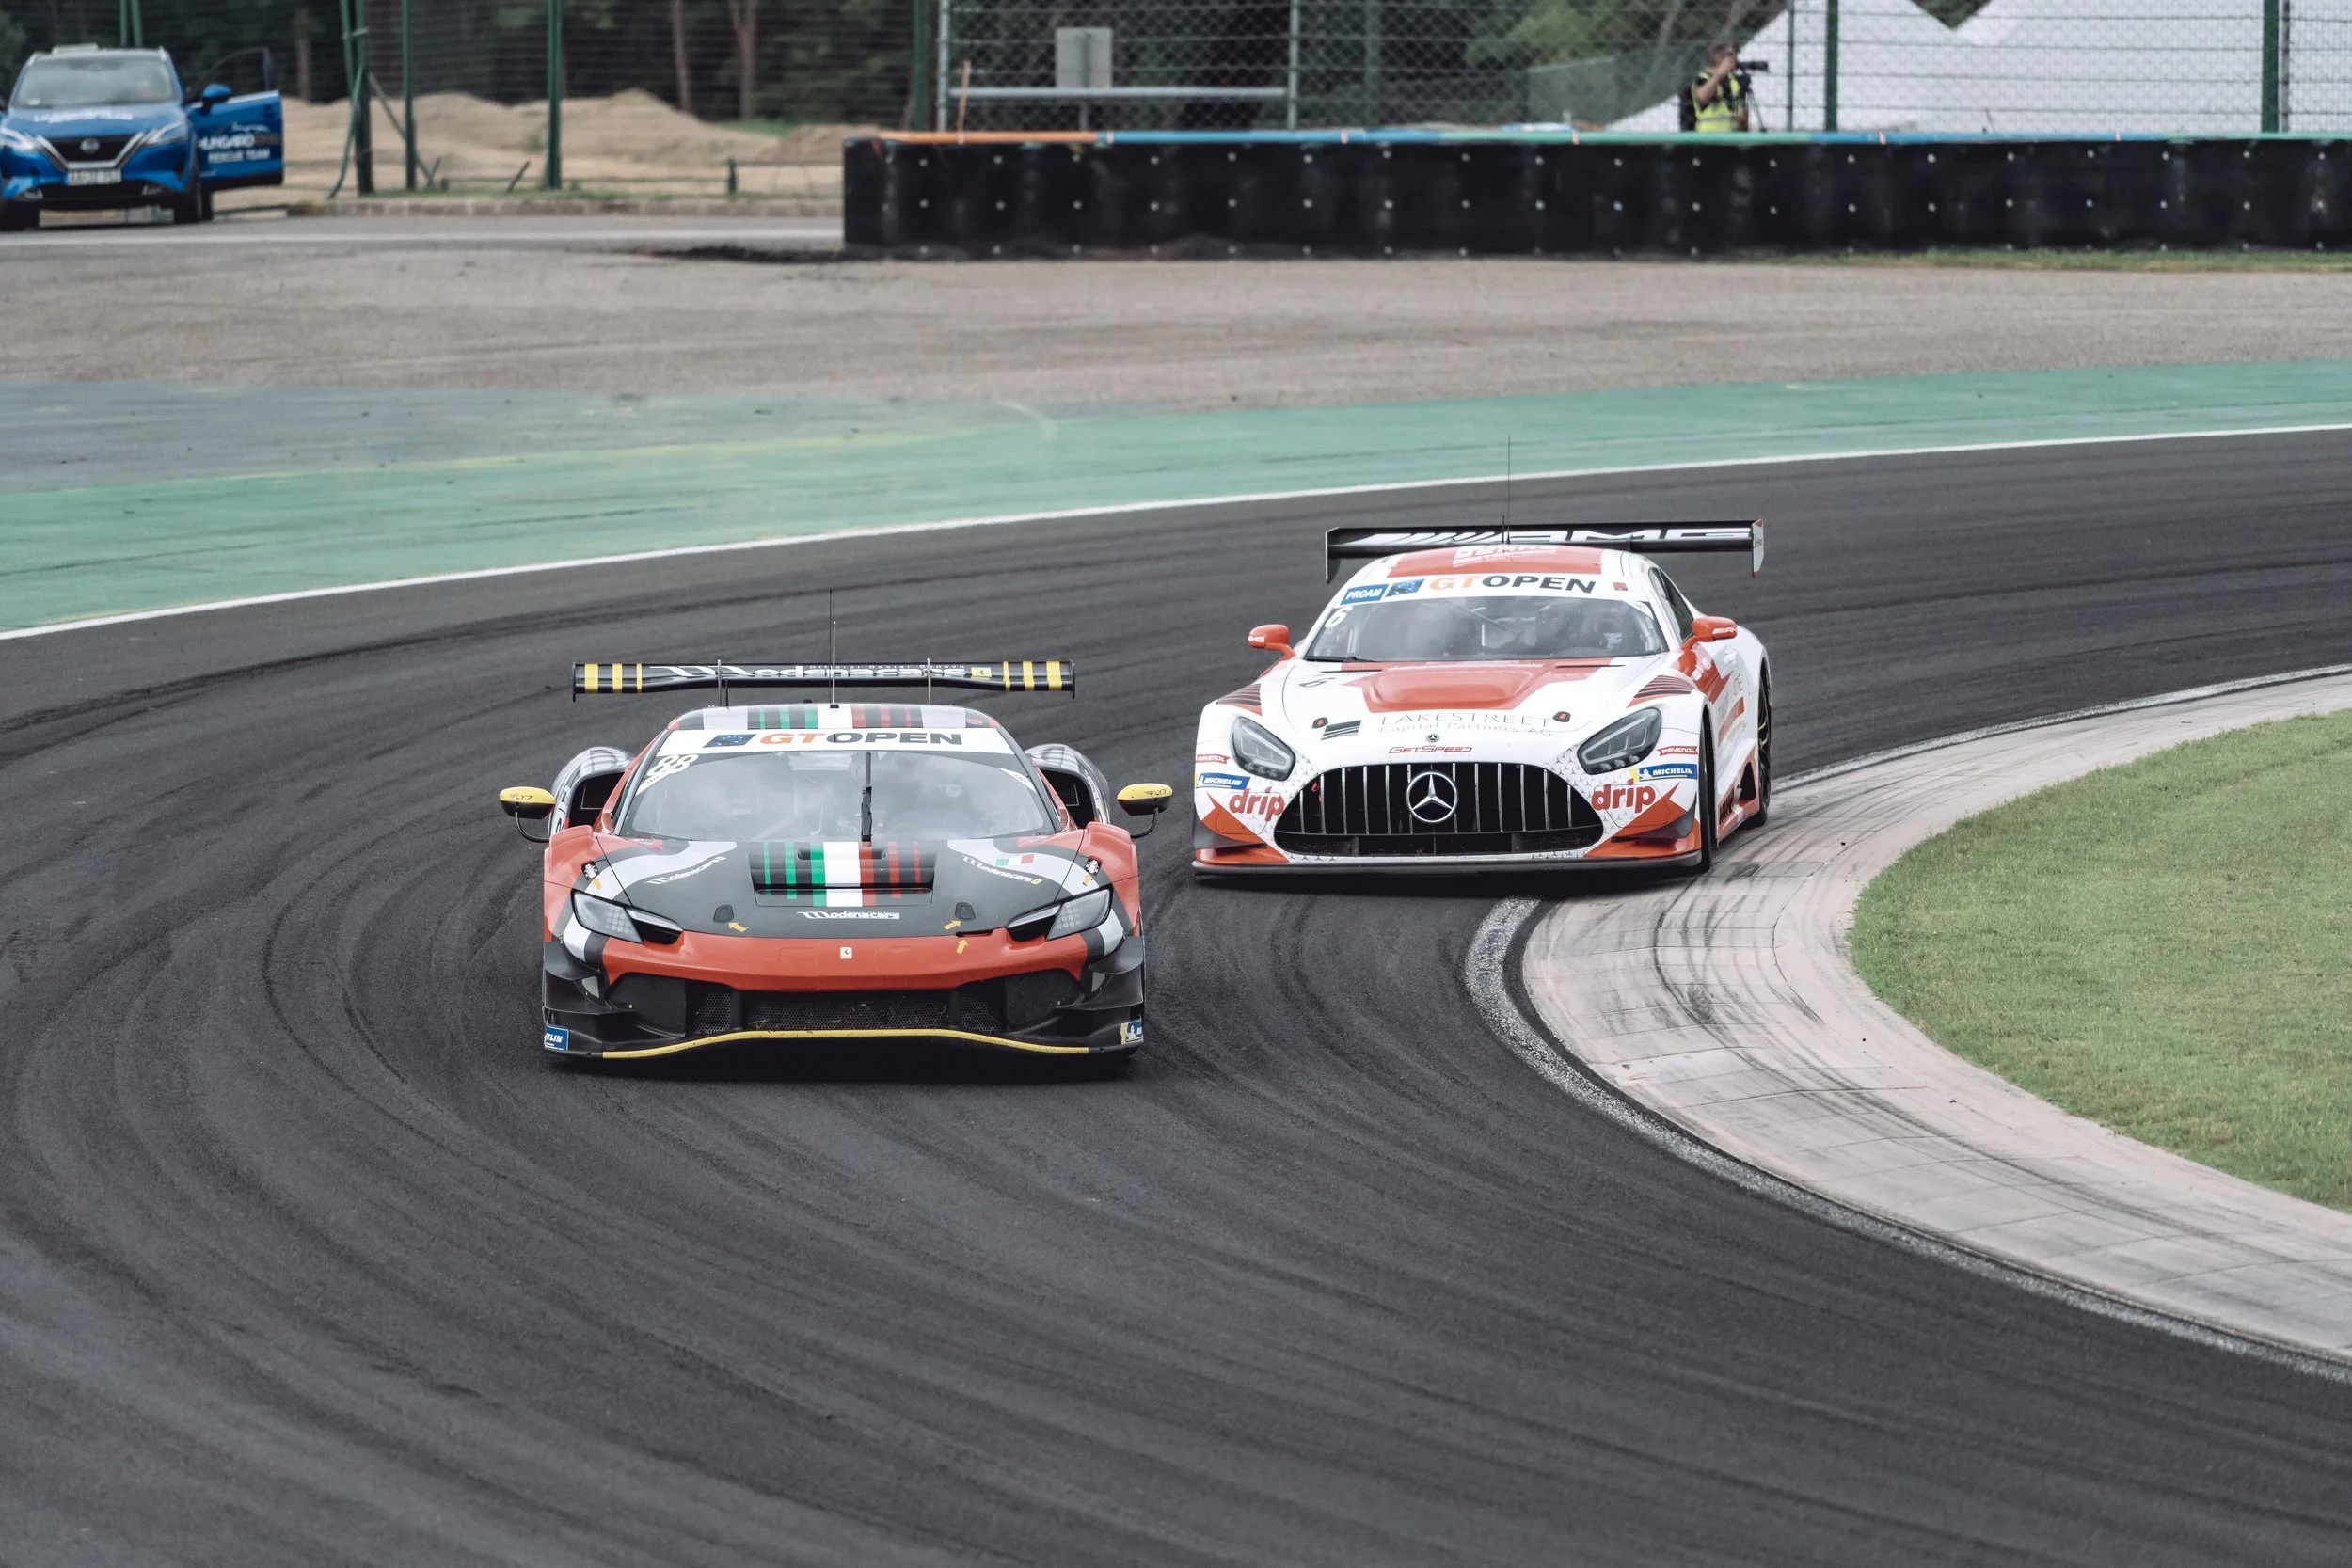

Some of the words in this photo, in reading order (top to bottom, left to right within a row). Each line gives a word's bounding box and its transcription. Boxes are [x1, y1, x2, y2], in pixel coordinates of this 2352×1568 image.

[1345, 588, 1384, 600] PROAM
[1324, 606, 1354, 628] 6
[1381, 712, 1552, 727] LAKESTREET
[1379, 722, 1439, 734] Capital
[1447, 721, 1519, 734] Partners
[1527, 727, 1552, 736] AG
[646, 753, 699, 777] 88
[1652, 768, 1693, 776] MICHELIN
[1203, 776, 1243, 786] MICHELIN
[1229, 786, 1285, 821] drip
[1591, 778, 1656, 814] drip
